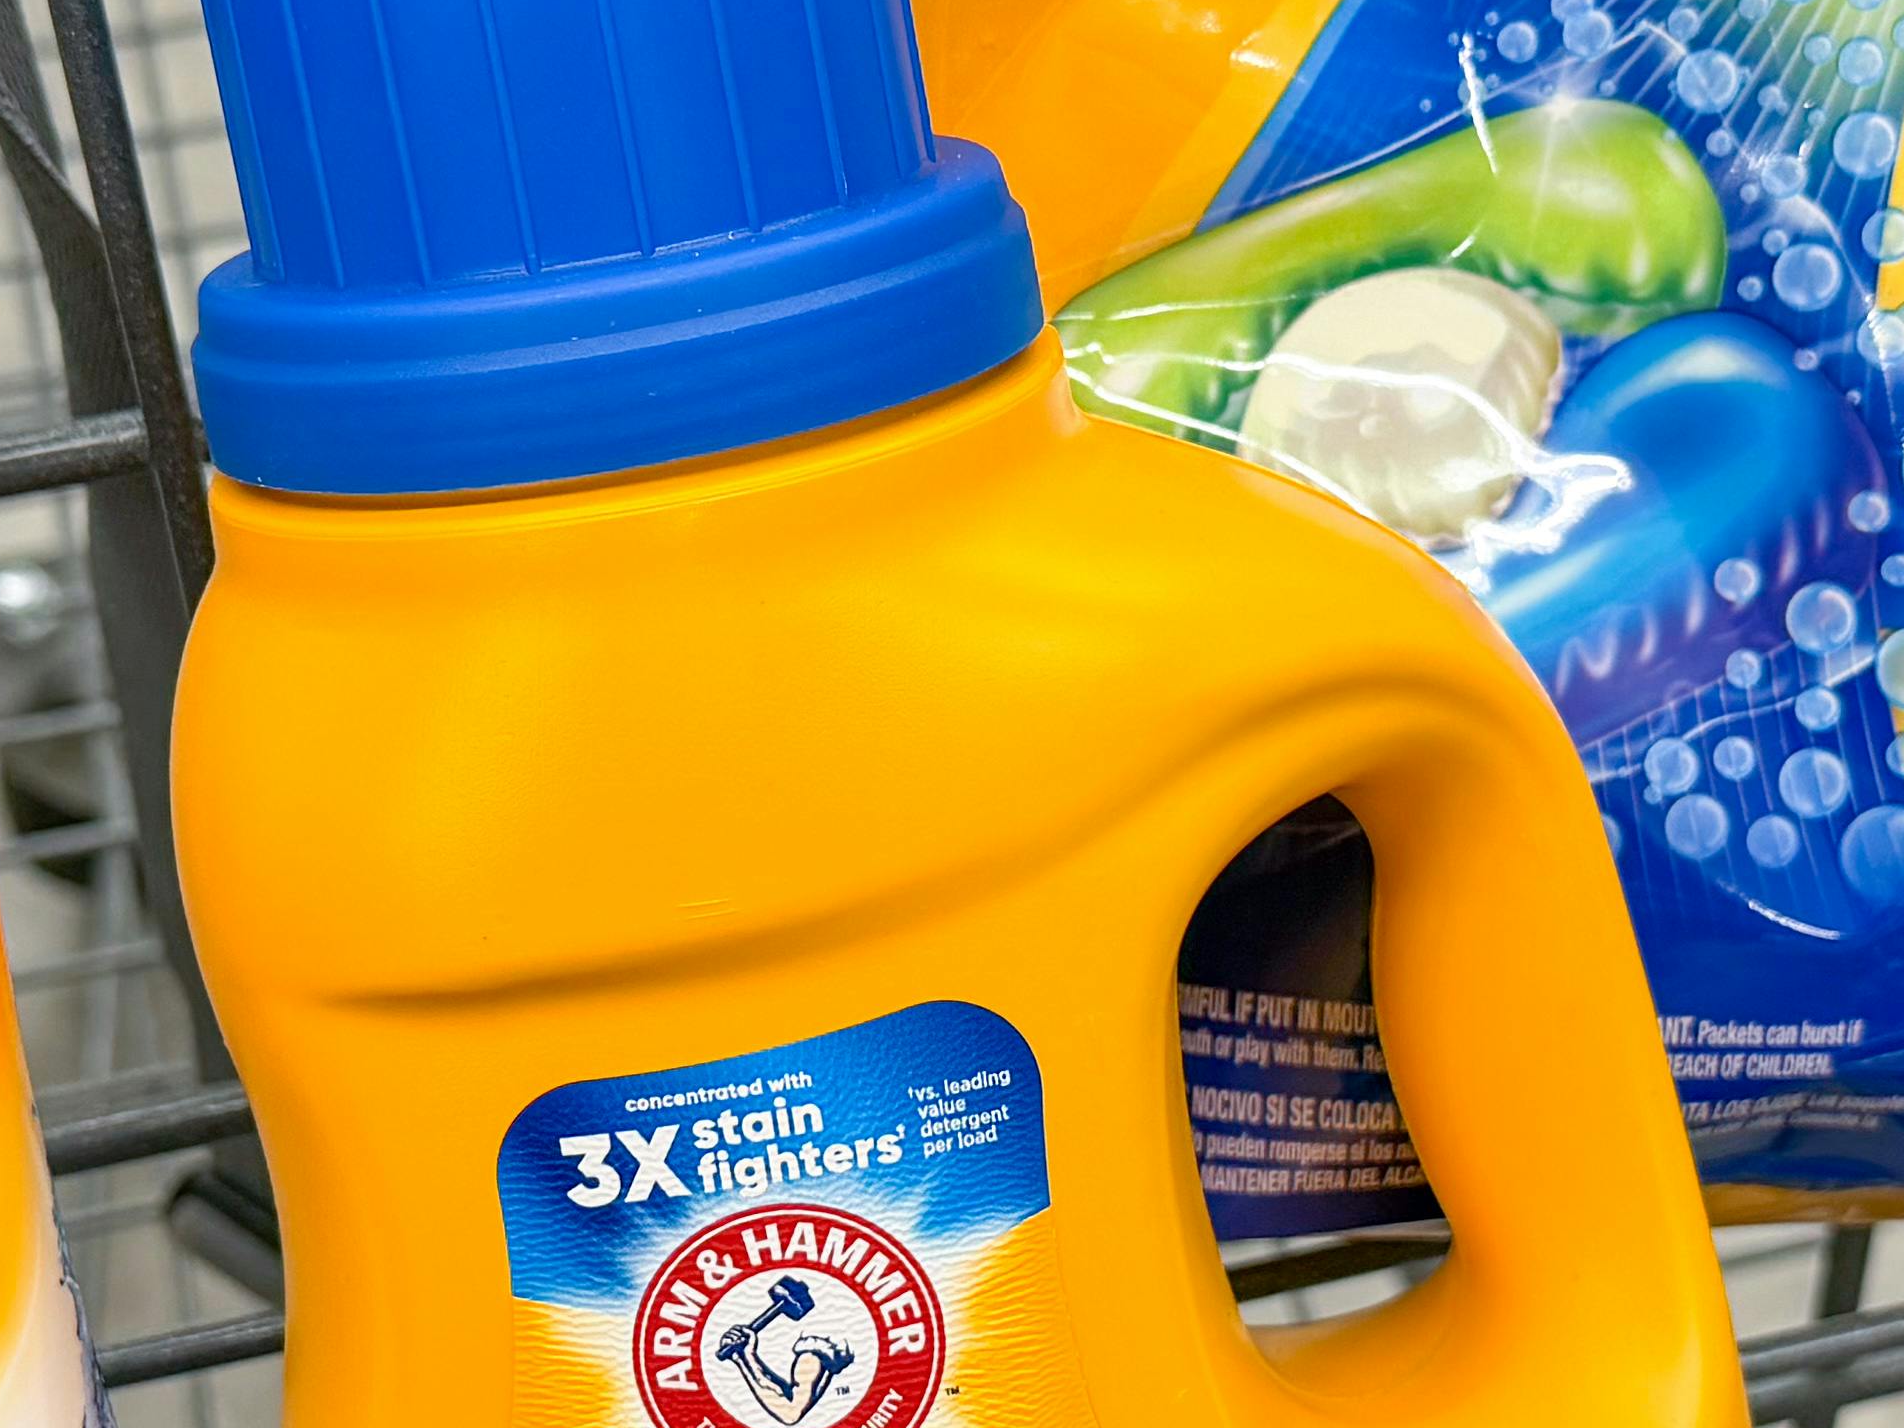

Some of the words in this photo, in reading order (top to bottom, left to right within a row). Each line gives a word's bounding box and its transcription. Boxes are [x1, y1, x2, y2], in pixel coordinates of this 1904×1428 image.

[1697, 1020, 1764, 1047] Packets
[1766, 1023, 1798, 1047] can
[1801, 1020, 1845, 1047] burst
[624, 1076, 764, 1113] concentrated
[768, 1070, 813, 1093] with
[944, 1069, 1011, 1096] leading
[918, 1098, 966, 1119] value
[920, 1104, 1009, 1138] detergent
[1192, 1085, 1264, 1123] NOCIVO
[692, 1096, 826, 1149] stain
[923, 1136, 954, 1159] per
[958, 1124, 998, 1149] load
[557, 1121, 696, 1209] 3X
[654, 1283, 703, 1392] ARM
[696, 1247, 737, 1291] &
[740, 1220, 928, 1358] HAMMER
